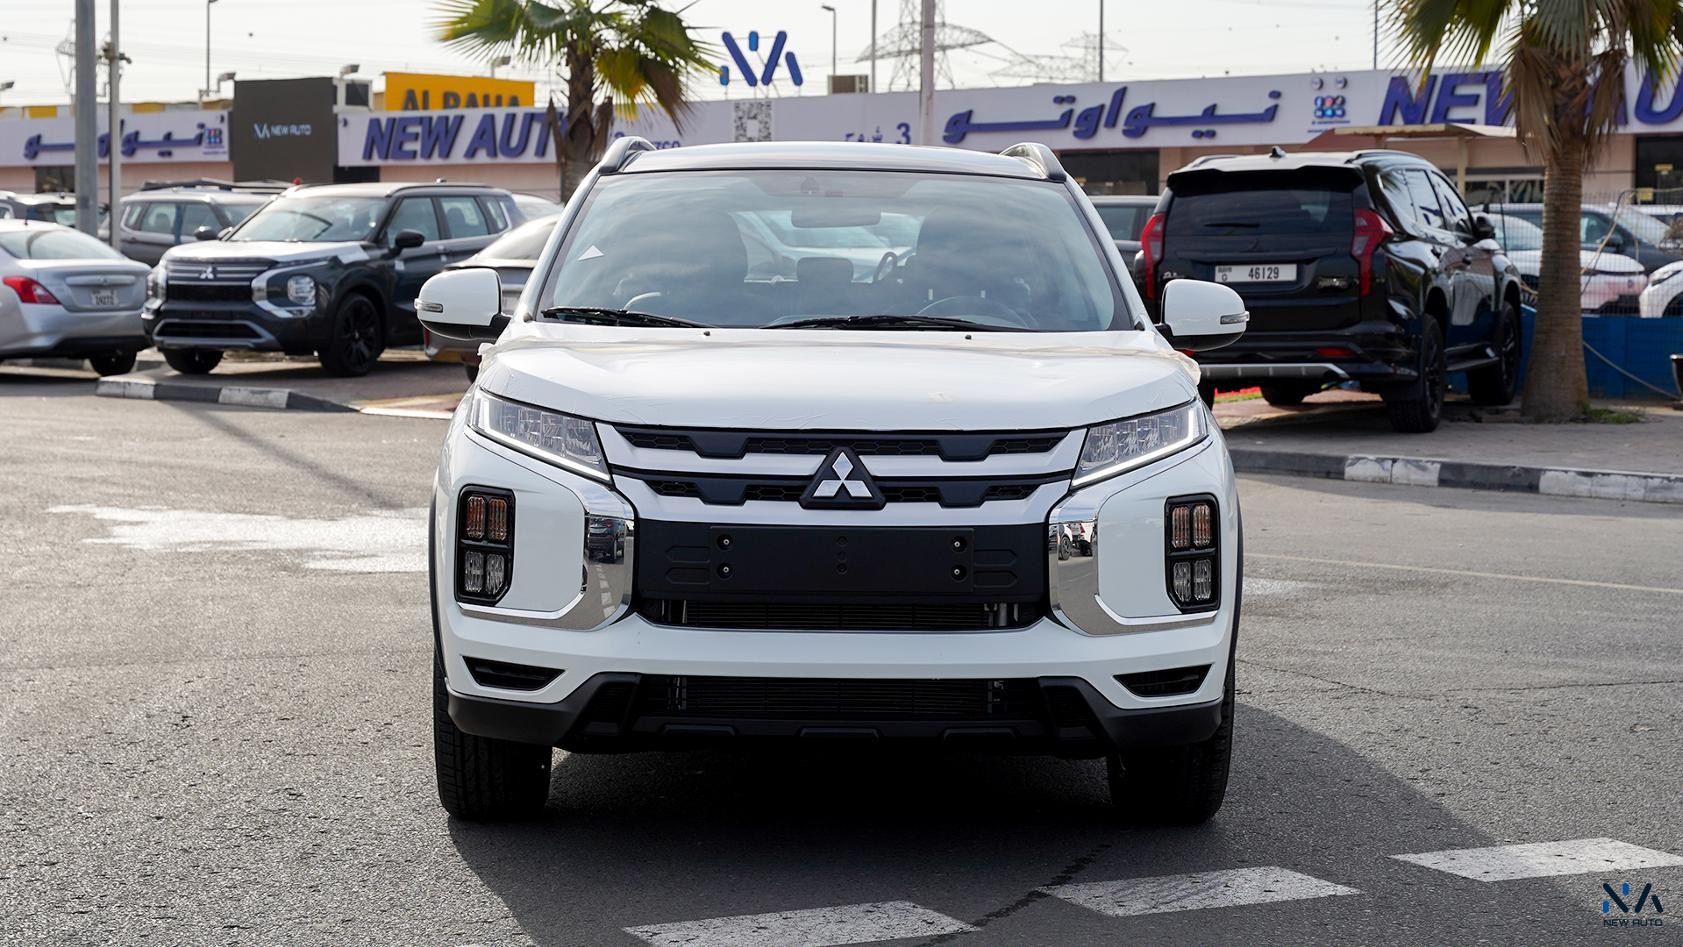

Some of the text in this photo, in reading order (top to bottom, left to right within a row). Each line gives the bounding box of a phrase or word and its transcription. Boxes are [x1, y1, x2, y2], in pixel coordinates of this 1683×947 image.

[271, 124, 289, 137] NEW
[289, 123, 311, 136] AUTO
[362, 111, 569, 161] NEW AUT
[1248, 266, 1280, 280] 46129
